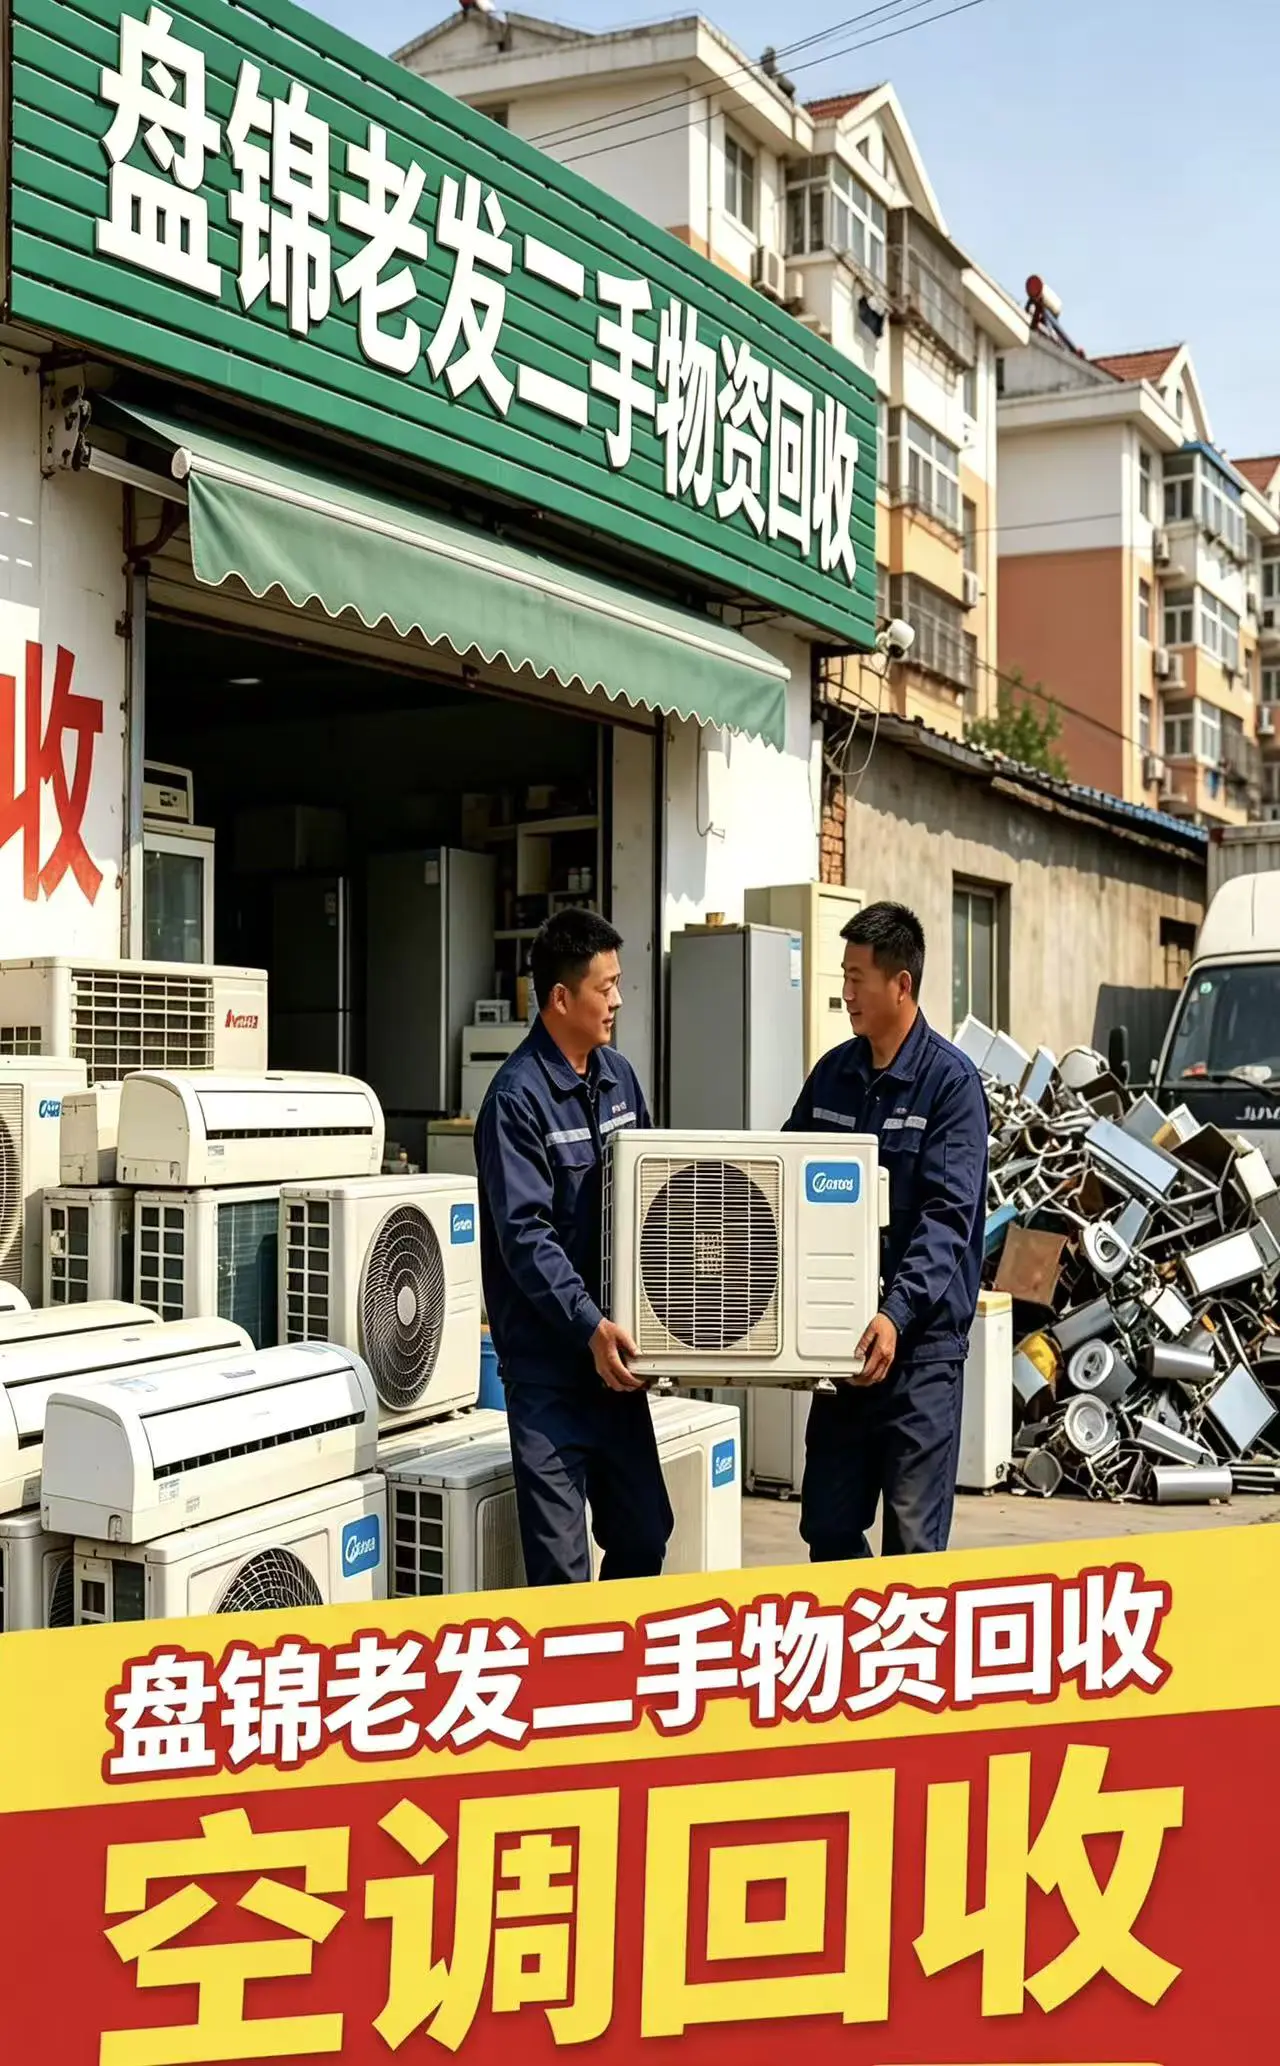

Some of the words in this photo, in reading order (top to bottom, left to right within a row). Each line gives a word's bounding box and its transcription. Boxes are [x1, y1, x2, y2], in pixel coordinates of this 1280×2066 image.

[95, 6, 860, 583] 盘锦老发二手物资回收
[0, 640, 103, 907] 收
